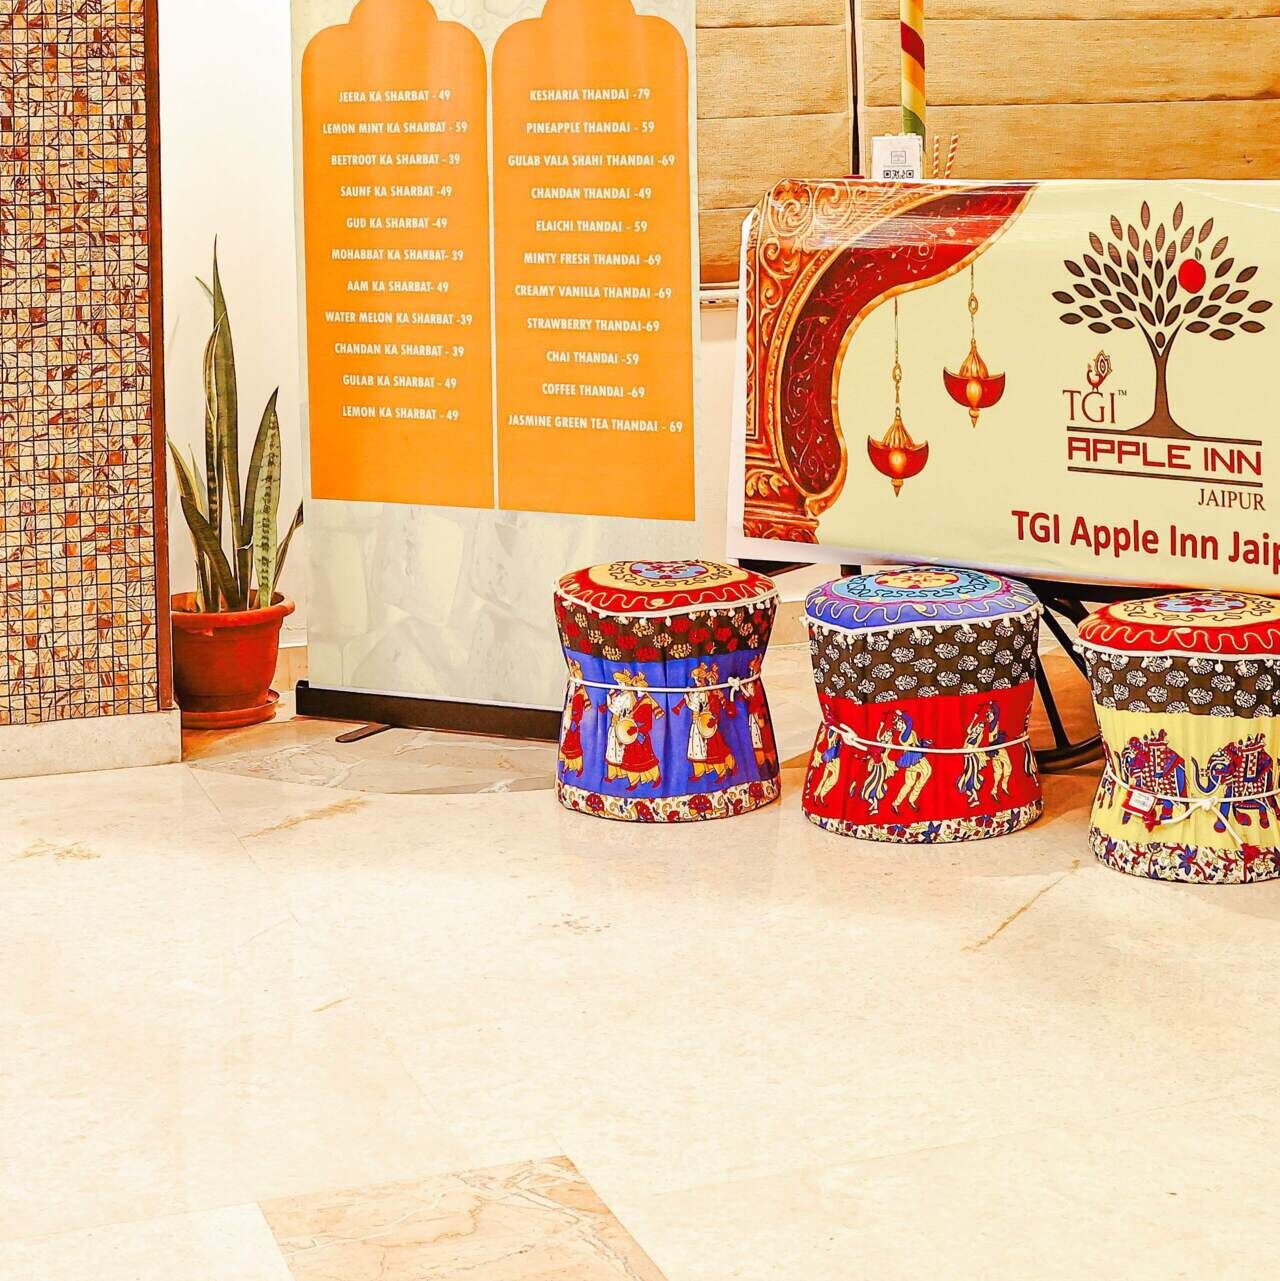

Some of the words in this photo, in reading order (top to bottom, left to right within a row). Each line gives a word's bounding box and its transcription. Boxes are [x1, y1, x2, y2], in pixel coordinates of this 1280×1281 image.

[339, 91, 367, 102] JEERA
[368, 91, 383, 102] KA
[384, 90, 430, 101] SHARBAT
[438, 89, 452, 101] 49
[529, 89, 580, 102] KESHARIA
[581, 88, 629, 101] THANDAI
[323, 123, 356, 134] LEMON
[358, 122, 385, 134] MINT
[386, 122, 401, 134] KA
[403, 121, 448, 134] SHARBAT
[455, 120, 469, 133] 59
[526, 121, 581, 134] PINEAPPLE
[582, 121, 631, 133] THANDAI
[642, 121, 655, 132] 59
[331, 154, 377, 165] BEETROOT
[379, 154, 393, 166] KA
[395, 154, 441, 165] SHARBAT
[448, 152, 461, 165] 39
[507, 155, 541, 166] GULAB
[543, 155, 570, 166] VALA
[571, 155, 603, 166] SHAHI
[606, 155, 655, 166] THANDAI
[340, 186, 371, 196] SAUNF
[373, 186, 388, 197] KA
[390, 186, 435, 197] SHARBAT
[531, 187, 582, 199] CHANDAN
[582, 187, 631, 200] THANDAI
[346, 218, 367, 228] GUD
[369, 218, 383, 229] KA
[385, 217, 429, 229] SHARBAT
[535, 220, 574, 232] ELAICHI
[576, 220, 623, 232] THANDAI
[634, 220, 648, 232] 59
[331, 249, 384, 260] MOHABBAT
[386, 250, 401, 260] KA
[451, 250, 465, 261] 39
[523, 253, 557, 264] MINTY
[559, 253, 591, 265] FRESH
[592, 253, 641, 265] THANDAI
[347, 281, 369, 292] AAM
[371, 280, 386, 292] KA
[436, 281, 449, 293] 49
[514, 284, 556, 297] CREAMY
[558, 286, 601, 298] VANILLA
[603, 286, 651, 299] THANDAI
[325, 311, 356, 322] WATER
[358, 311, 393, 324] MELON
[395, 312, 411, 323] KA
[411, 312, 454, 325] SHARBAT
[526, 318, 593, 331] STRAWBERRY
[334, 343, 382, 355] CHANDAN
[384, 344, 399, 356] KA
[400, 344, 443, 357] SHARBAT
[452, 346, 465, 357] 39
[546, 351, 571, 363] CHAI
[573, 352, 618, 365] THANDAI
[342, 374, 375, 386] GULAB
[376, 375, 391, 386] KA
[393, 375, 435, 388] SHARBAT
[444, 377, 458, 389] 49
[541, 383, 577, 396] COFFEE
[579, 384, 624, 398] THANDAI
[1062, 389, 1116, 424] TGI
[342, 406, 376, 418] LEMON
[378, 407, 393, 418] KA
[394, 407, 437, 420] SHARBAT
[446, 410, 460, 422] 49
[508, 414, 552, 427] JASMINE
[554, 416, 589, 429] GREEN
[590, 418, 609, 430] TEA
[611, 418, 658, 433] THANDAI
[669, 421, 683, 433] 69
[1067, 436, 1192, 470] APPLE
[1203, 447, 1262, 476] INN
[1198, 488, 1266, 511] JAIPUR
[1011, 510, 1060, 544] TGI
[1069, 516, 1159, 558] Apple
[1169, 524, 1219, 561] Inn
